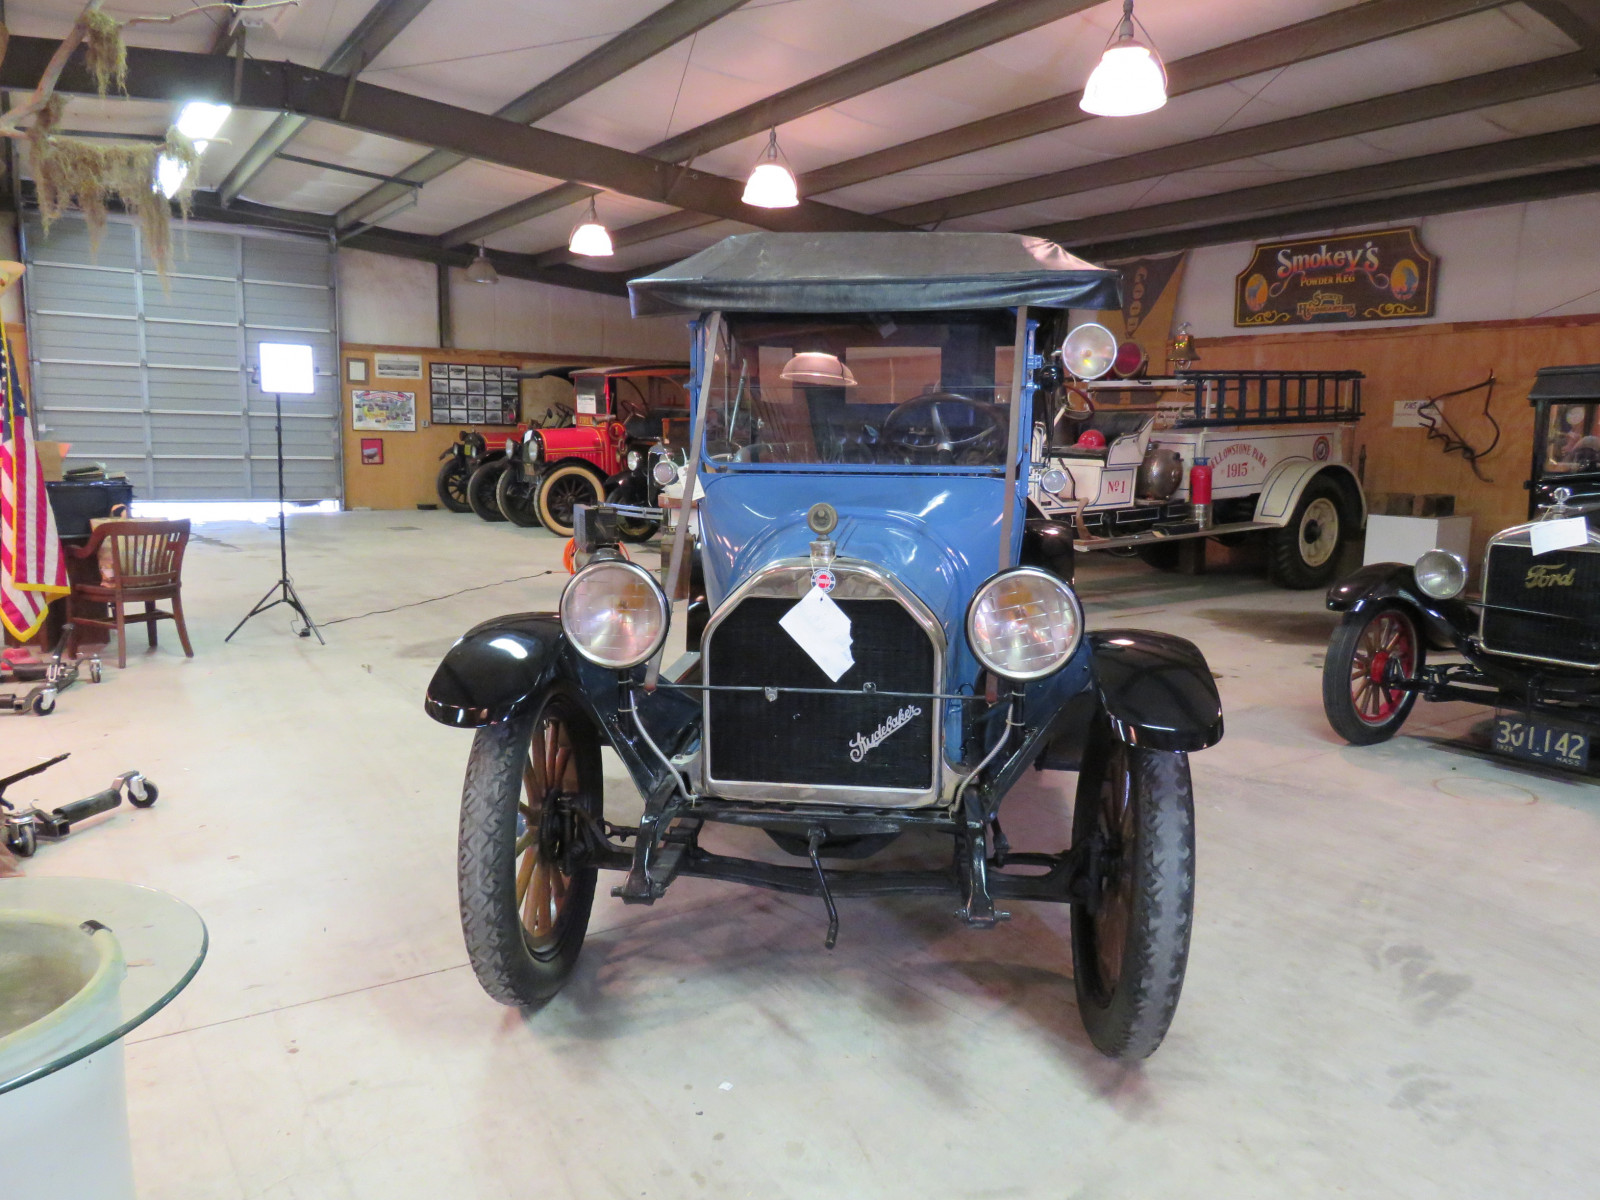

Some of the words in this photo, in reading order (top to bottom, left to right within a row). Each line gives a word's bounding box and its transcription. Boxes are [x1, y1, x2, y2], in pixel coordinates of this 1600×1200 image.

[1277, 241, 1379, 278] Smokey's
[1336, 273, 1356, 284] KEG
[1210, 443, 1252, 469] ELLOWSTONE
[1252, 447, 1268, 468] PARK
[1227, 462, 1249, 478] 1915
[1524, 563, 1576, 589] Ford
[849, 704, 922, 763] Studebaker
